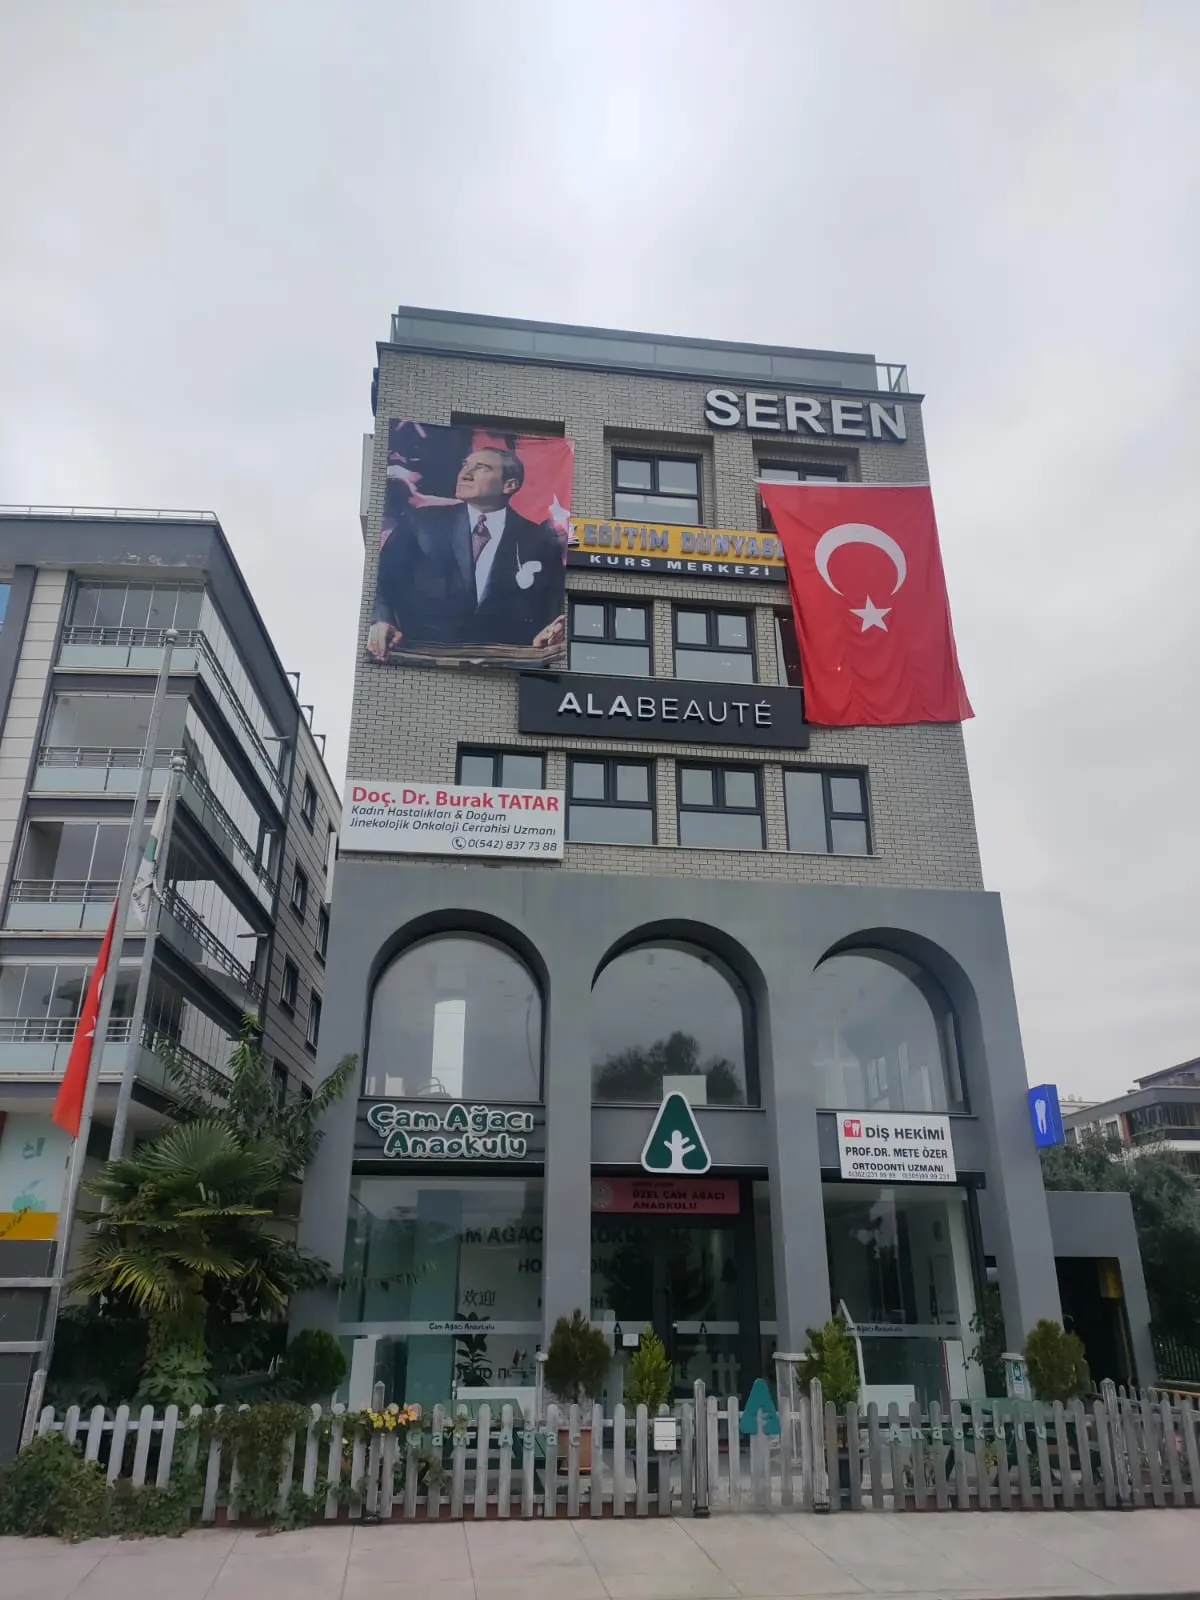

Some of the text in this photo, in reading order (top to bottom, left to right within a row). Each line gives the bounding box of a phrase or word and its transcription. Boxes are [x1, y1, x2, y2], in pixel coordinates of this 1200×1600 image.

[704, 388, 908, 441] SEREN
[583, 523, 670, 551] EĞİTİM
[590, 554, 770, 576] KURS MERKEZİ
[556, 691, 773, 726] ALABEAUTÉ
[352, 786, 560, 812] Doç. Dr. Burak TATAR
[351, 805, 507, 822] Kadın Hastalıkları & Doğum
[349, 817, 556, 836] Jinekolojik Onkoloji Cerrahisi Uzmanı
[467, 839, 558, 852] 0(542) 837 73 88
[368, 1104, 534, 1137] Çam Ağacı
[384, 1130, 527, 1158] Anaokulu
[865, 1125, 945, 1142] DİŞ HEKİMİ
[893, 1148, 920, 1158] METE
[922, 1147, 948, 1159] ÖZER
[852, 1162, 944, 1173] ORTODONTİ UZMANI
